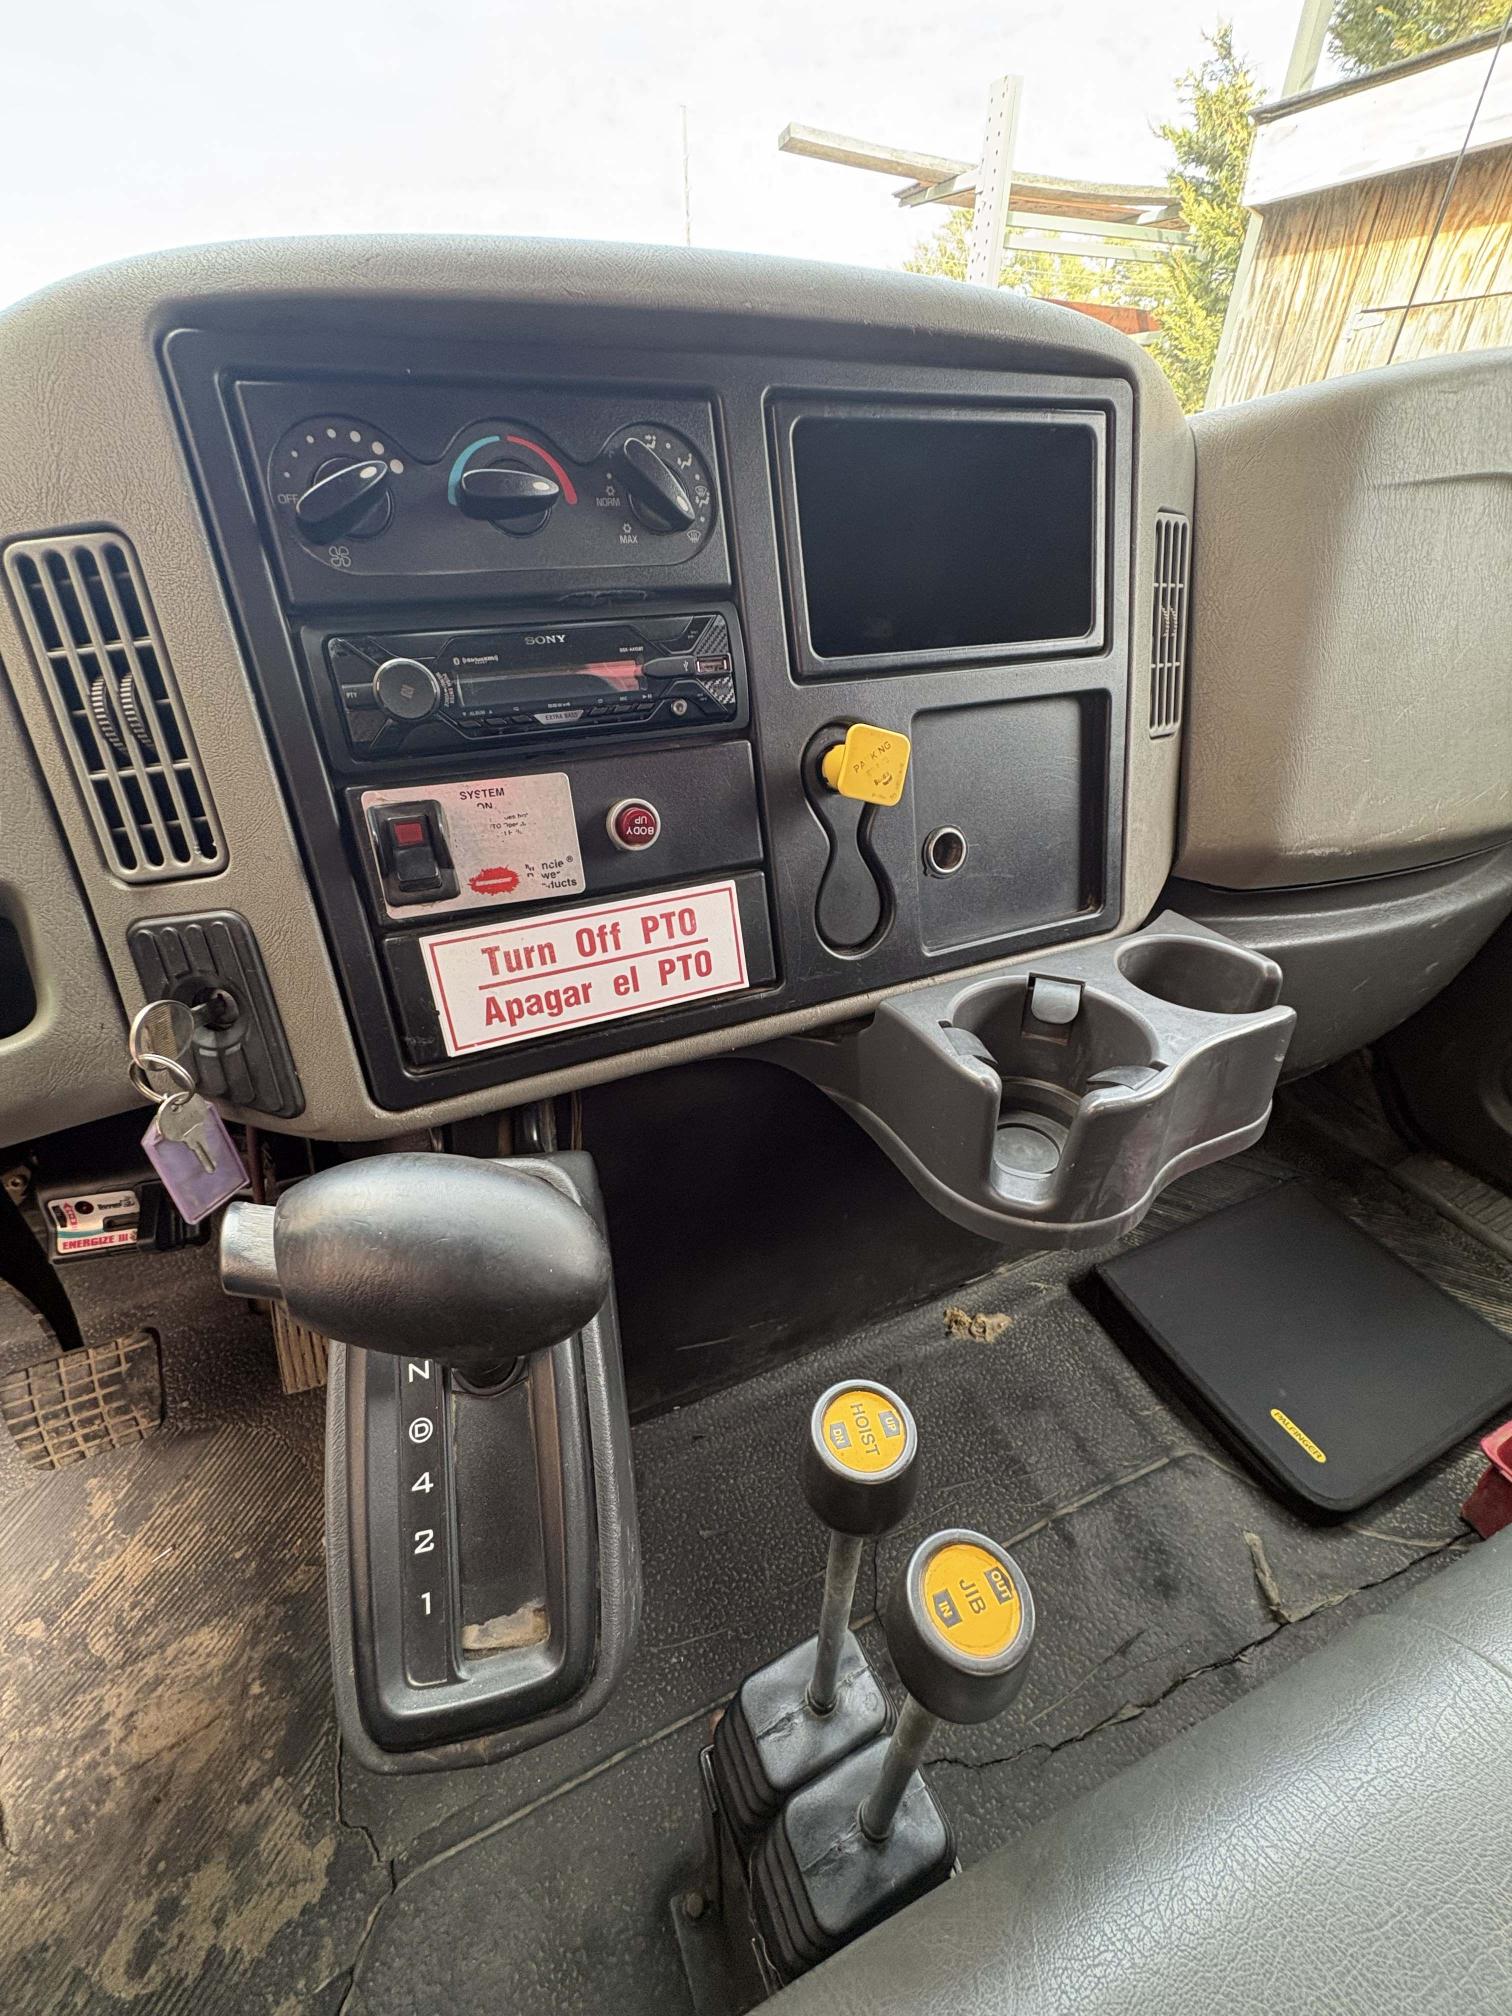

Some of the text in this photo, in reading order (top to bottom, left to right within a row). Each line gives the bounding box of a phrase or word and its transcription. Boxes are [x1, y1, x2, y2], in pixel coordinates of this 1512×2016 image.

[277, 493, 299, 505] OFF
[596, 497, 620, 507] NORM
[619, 534, 638, 544] MAX
[525, 634, 566, 646] SONY
[852, 741, 892, 773] PAKNG
[459, 787, 505, 800] SYSTEM
[626, 826, 655, 835] BODY
[634, 815, 648, 825] UP
[481, 907, 697, 976] Turn Off PTO
[485, 950, 712, 1027] Apagar el PTO
[62, 1233, 129, 1250] ENERGIZE III
[408, 1360, 430, 1383] N
[411, 1419, 431, 1441] D
[850, 1403, 880, 1456] HOIST
[884, 1416, 898, 1432] UP
[1273, 1411, 1322, 1459] PALFINGER
[832, 1427, 846, 1444] DN
[411, 1471, 434, 1493] 4
[414, 1529, 435, 1554] 2
[990, 1570, 1012, 1599] OUT
[421, 1592, 431, 1615] 1
[959, 1579, 986, 1615] JIB
[938, 1601, 953, 1618] IN
